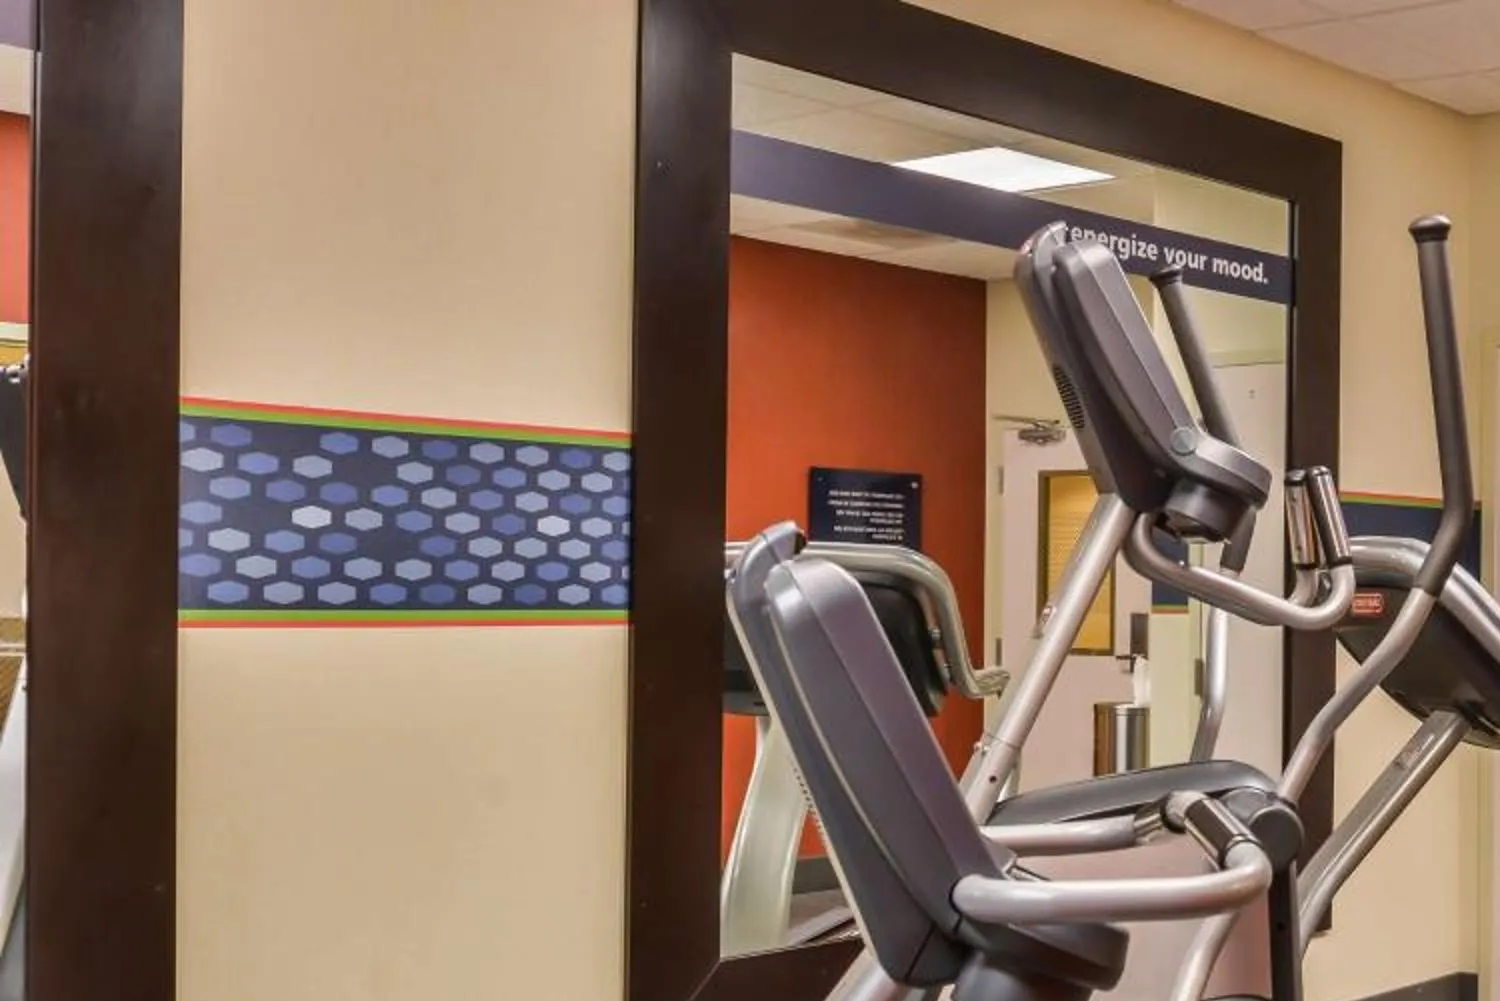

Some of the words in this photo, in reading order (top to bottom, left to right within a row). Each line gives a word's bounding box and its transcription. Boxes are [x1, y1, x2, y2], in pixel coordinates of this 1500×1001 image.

[1070, 226, 1158, 261] energize
[1163, 246, 1208, 271] your
[1212, 257, 1269, 284] mood.
